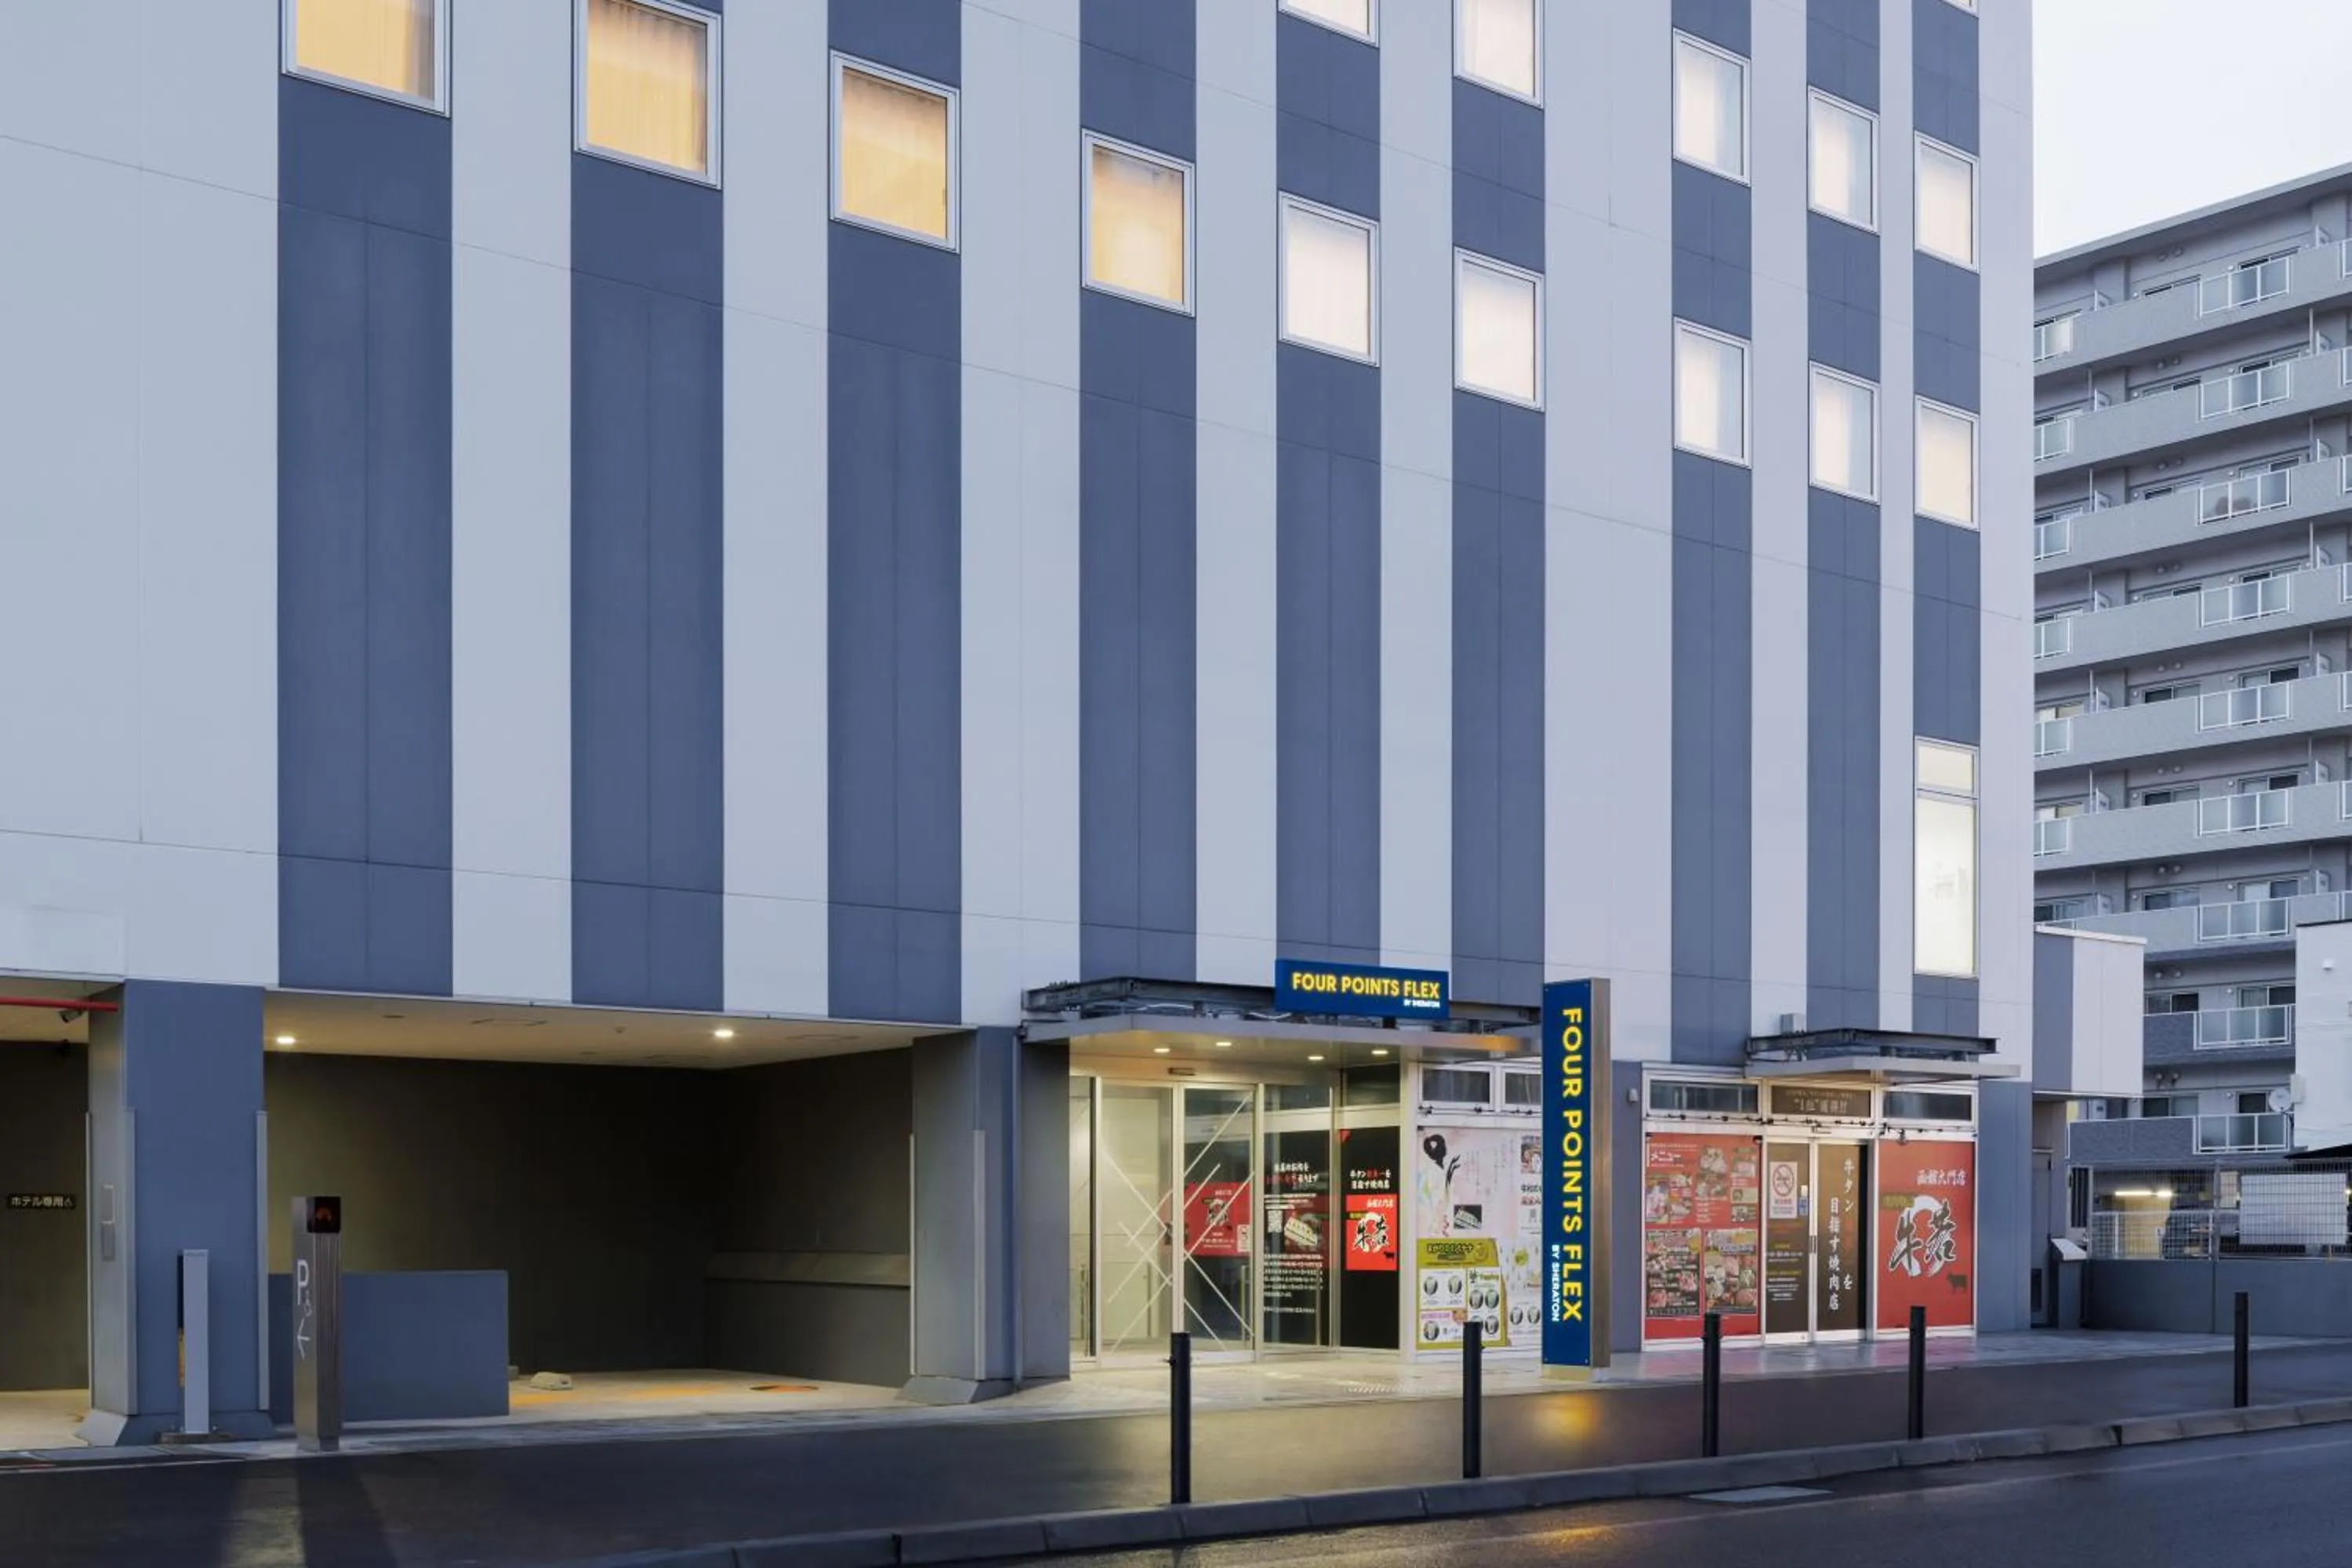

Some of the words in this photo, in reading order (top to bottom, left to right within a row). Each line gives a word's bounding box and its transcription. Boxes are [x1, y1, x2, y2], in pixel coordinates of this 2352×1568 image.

[1292, 972, 1336, 992] FOUR
[1341, 976, 1399, 996] POINTS
[1403, 980, 1440, 999] FLEX
[1563, 1007, 1583, 1098] FOUR
[1563, 1110, 1583, 1233] POINTS
[1552, 1244, 1560, 1258] BY
[297, 1259, 310, 1306] P
[1552, 1263, 1560, 1322] SHERATON
[1563, 1244, 1583, 1322] FLEX
